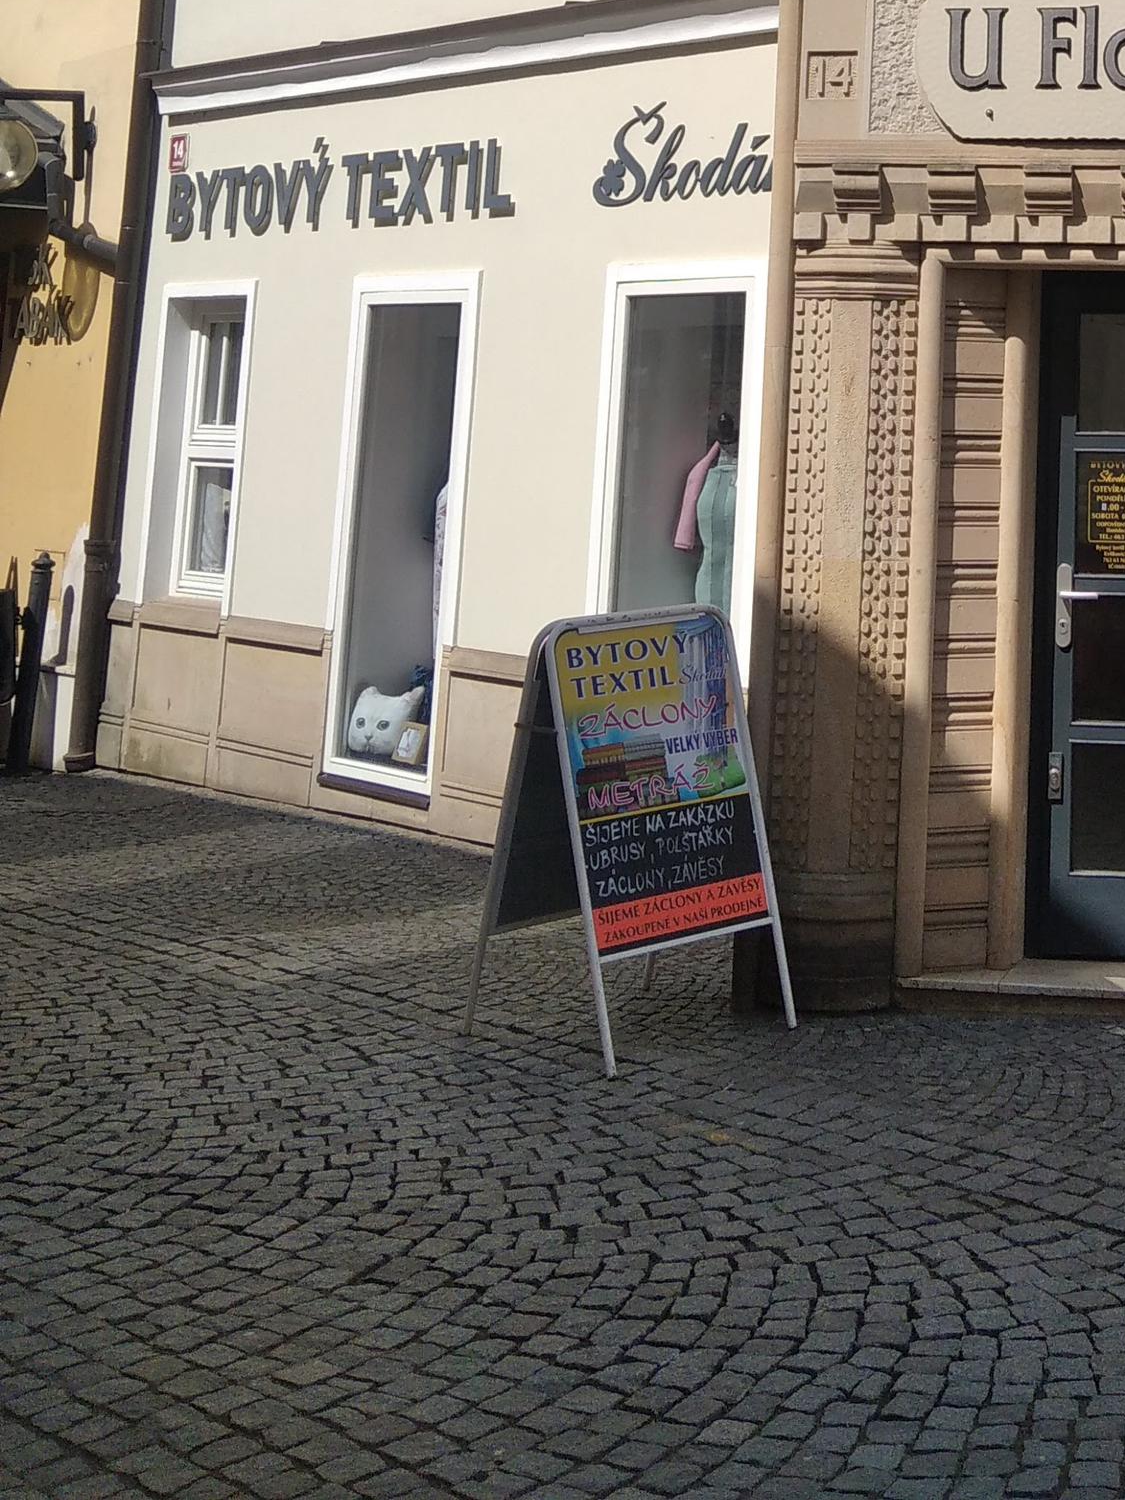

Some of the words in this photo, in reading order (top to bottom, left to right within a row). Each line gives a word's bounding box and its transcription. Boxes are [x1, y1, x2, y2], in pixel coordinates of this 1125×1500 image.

[944, 6, 1008, 91] U
[815, 57, 853, 98] 14
[592, 101, 772, 208] Škodá
[165, 136, 332, 240] BYTOVÝ
[341, 137, 514, 226] TEXTIL
[566, 630, 688, 669] BYTOVÝ
[570, 665, 675, 698] TEXTIL
[577, 694, 717, 739] ZÁCLONY
[665, 729, 700, 755] VELKÝ
[587, 762, 714, 811] METRÁŽ
[585, 817, 640, 848] ŠIJEME
[646, 813, 666, 835] NA
[667, 800, 735, 829] ZAKÁZKU
[598, 905, 641, 926] ŠIJEME
[644, 891, 703, 916] ZÁCLONY
[706, 890, 715, 901] A
[604, 916, 671, 943] ZAKOUPENÉ
[673, 916, 680, 927] V
